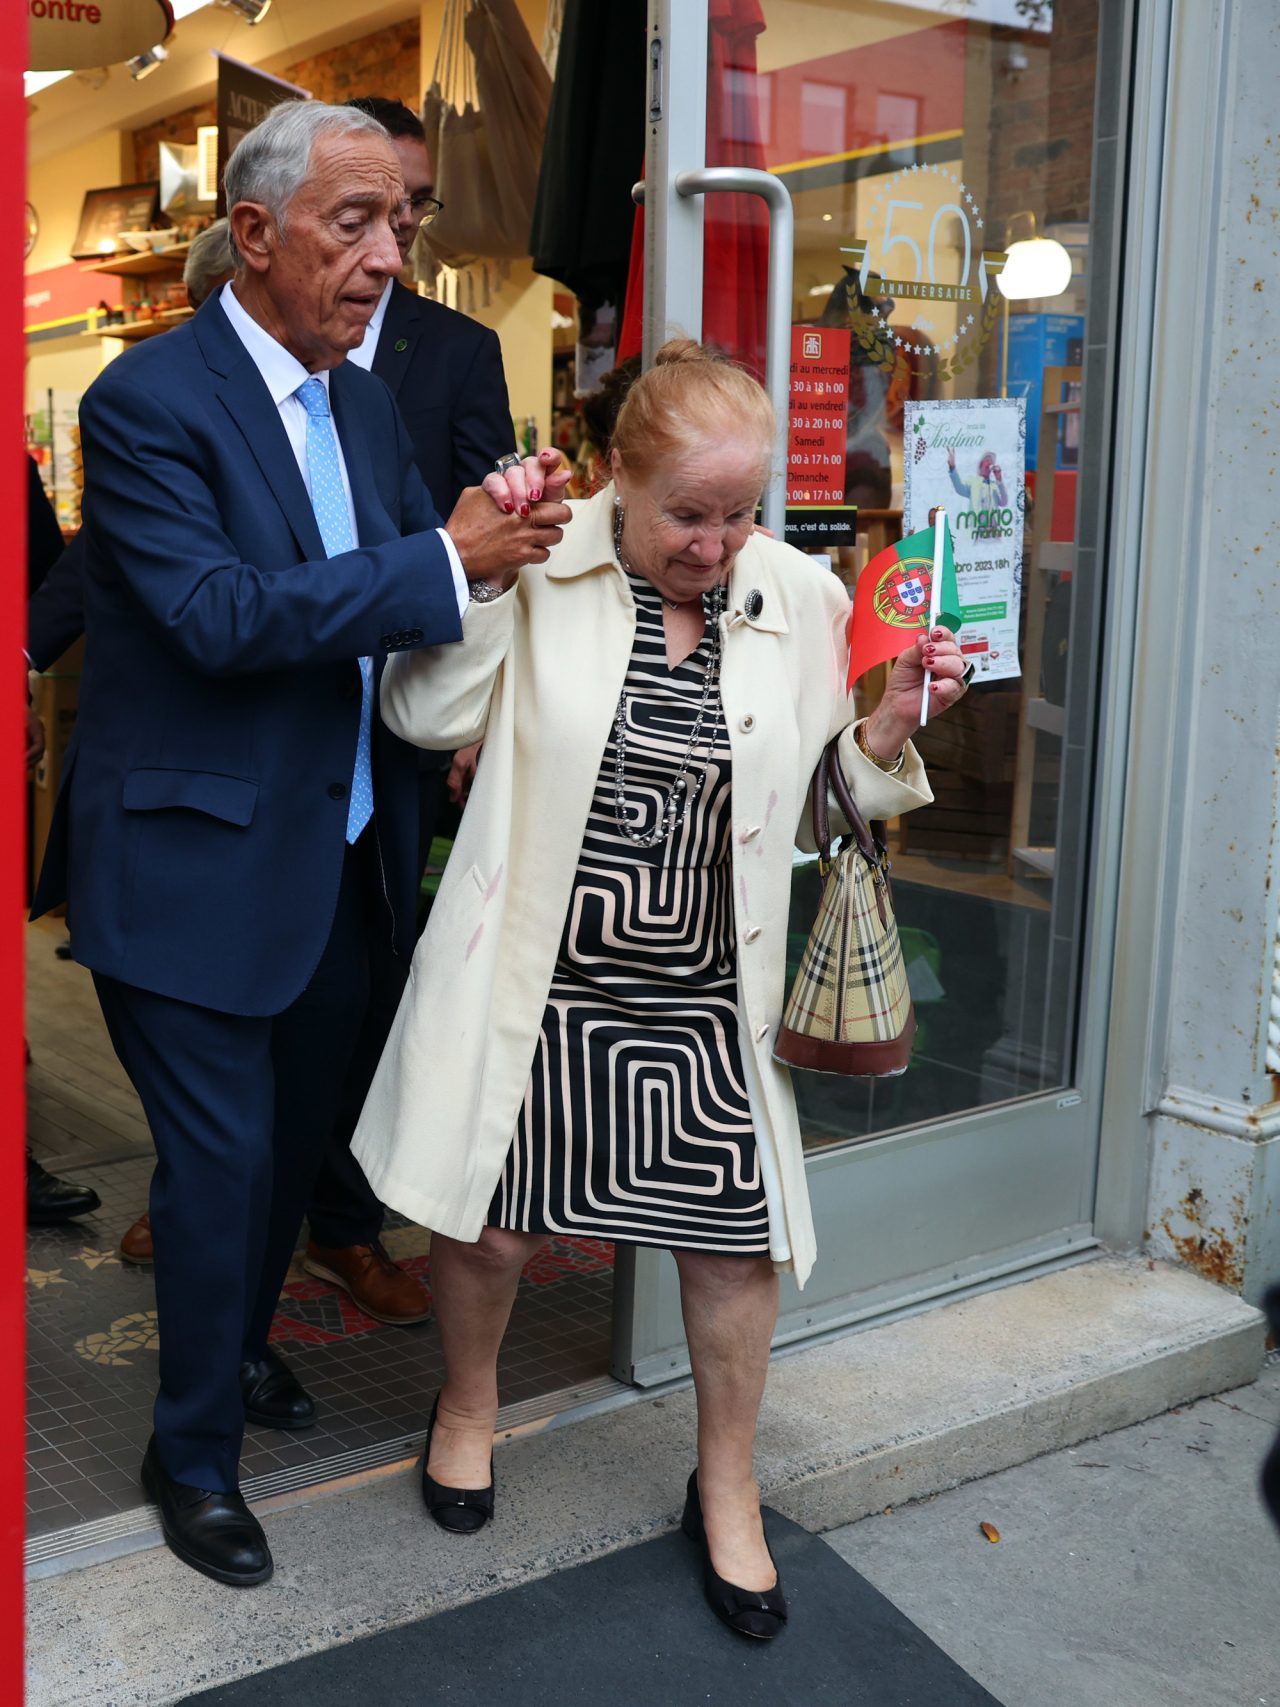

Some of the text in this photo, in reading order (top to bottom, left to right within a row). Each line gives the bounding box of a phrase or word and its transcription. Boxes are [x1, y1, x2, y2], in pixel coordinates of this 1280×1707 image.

[880, 199, 972, 287] 50
[880, 282, 972, 300] ANNIVERSAIRE
[812, 365, 849, 375] mercredi
[793, 381, 844, 394] 30 à 18 h 00
[798, 402, 807, 410] au
[810, 402, 846, 412] vendredi
[792, 417, 843, 429] 30 à 20 h 00
[794, 435, 825, 446] Samedi
[791, 454, 842, 465] 00 à 17 h 00
[788, 472, 830, 482] Dimanche
[793, 490, 803, 500] 00
[813, 490, 823, 500] 17
[824, 490, 830, 500] h
[832, 490, 842, 500] 00
[956, 508, 1013, 530] mario
[785, 524, 799, 533] ous,
[819, 522, 828, 531] du
[830, 522, 851, 531] solide.
[956, 561, 972, 573] bro
